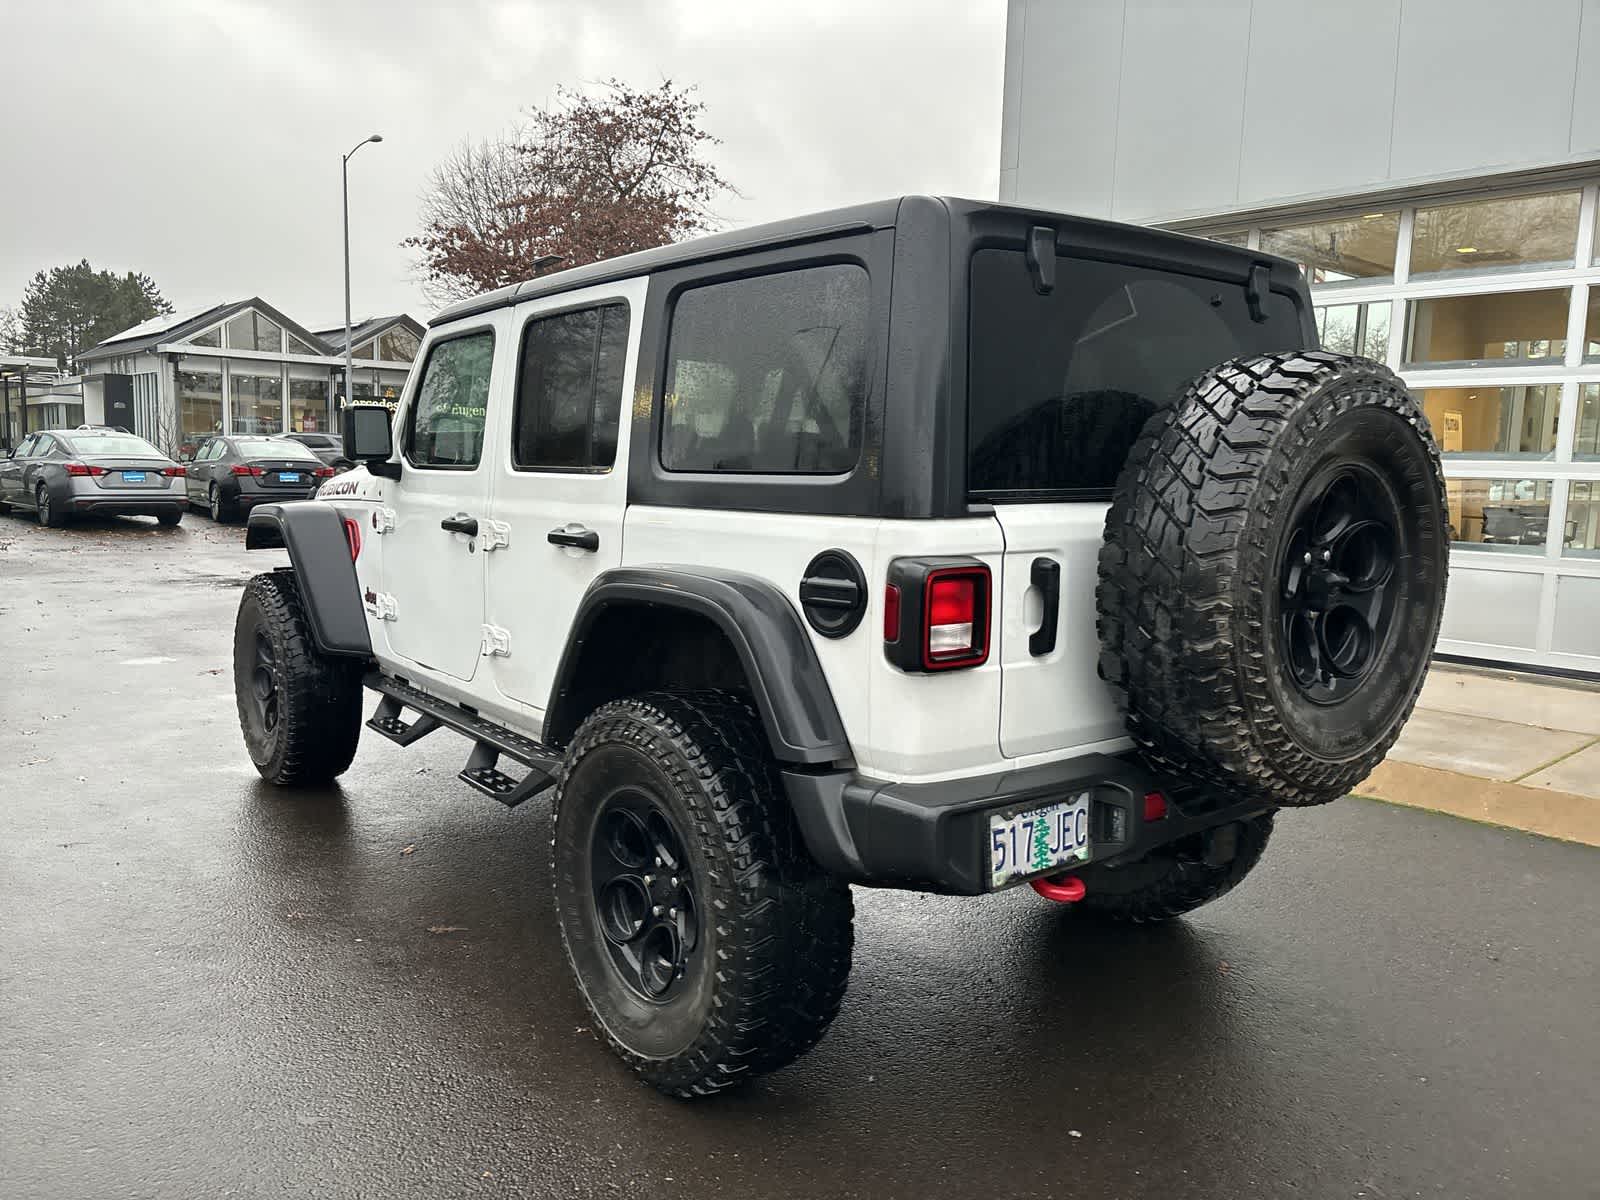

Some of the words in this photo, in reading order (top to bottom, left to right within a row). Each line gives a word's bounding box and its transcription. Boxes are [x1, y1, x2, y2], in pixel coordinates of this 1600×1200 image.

[452, 403, 486, 418] Eugen
[992, 822, 1034, 872] 517
[1050, 808, 1086, 855] JEC
